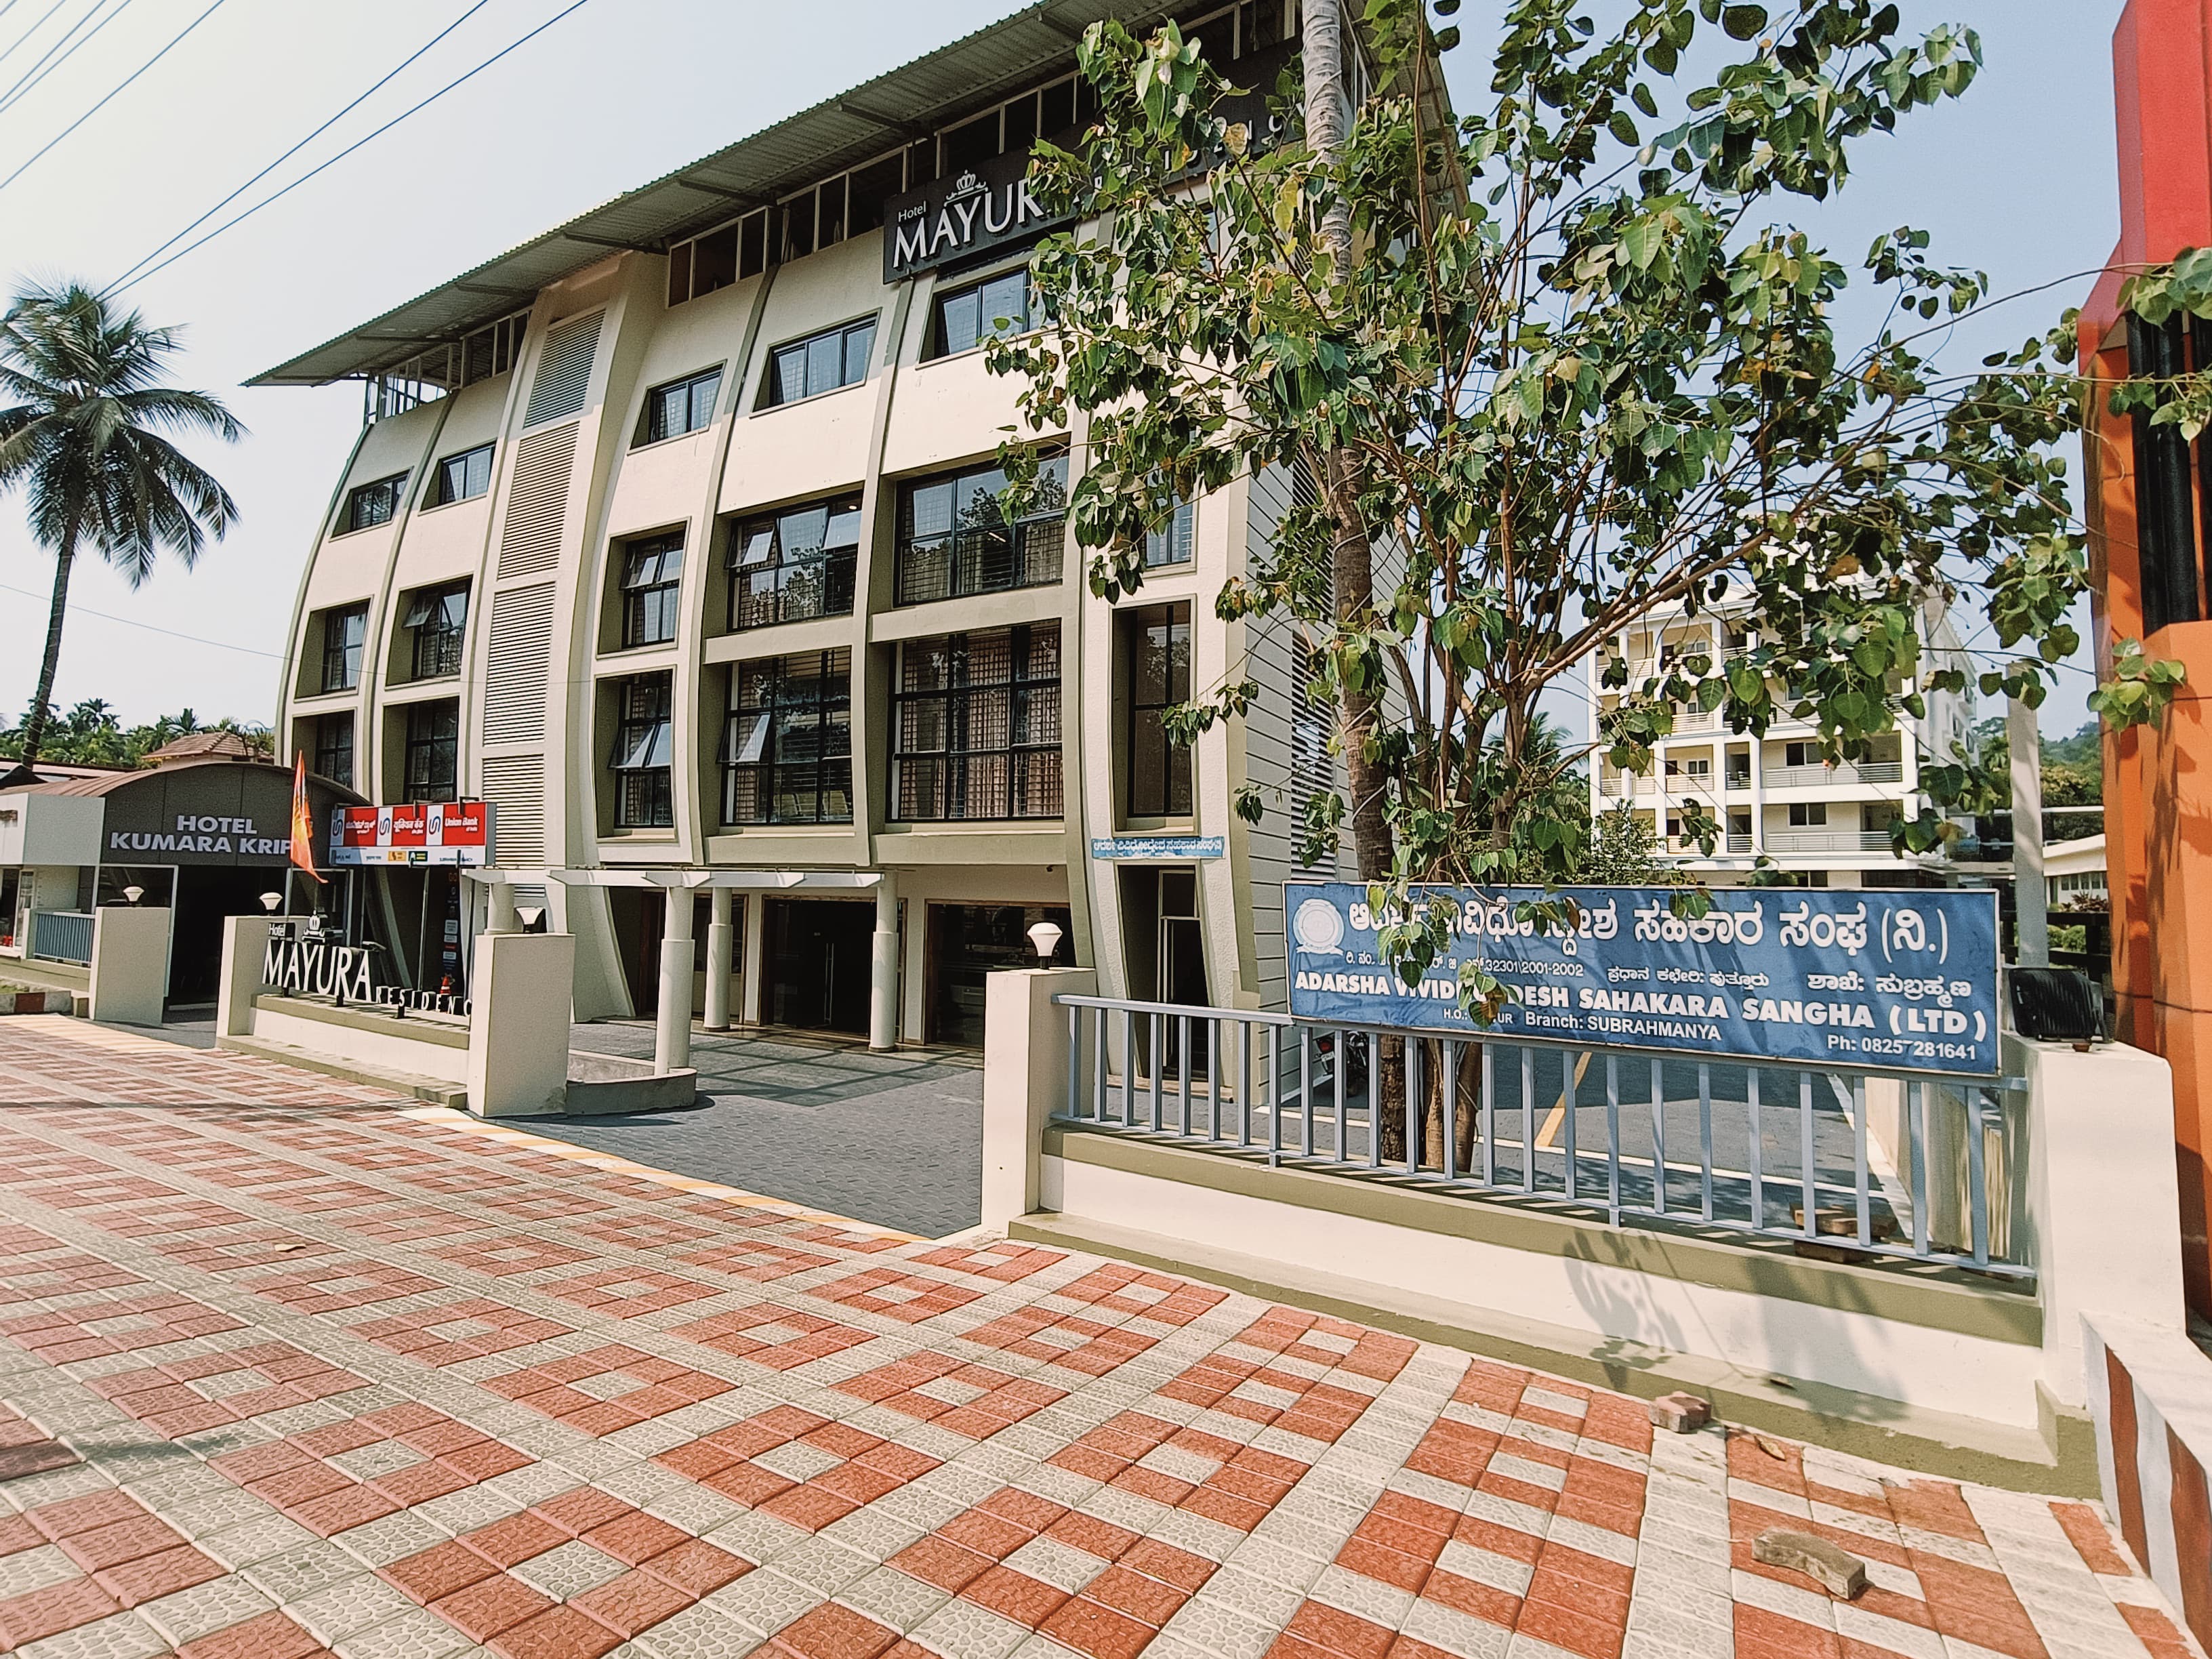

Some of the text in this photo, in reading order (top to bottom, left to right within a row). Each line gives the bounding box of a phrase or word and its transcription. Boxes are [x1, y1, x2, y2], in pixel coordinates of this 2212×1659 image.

[898, 201, 926, 222] Hotel
[893, 178, 1045, 268] MAYUR
[177, 815, 258, 834] HOTEL
[462, 817, 478, 826] Bank
[110, 832, 232, 853] KUMARA
[268, 922, 286, 937] Hotel
[262, 939, 371, 1002] MAYURA
[1294, 972, 1391, 996] ADARSHA
[1578, 988, 1729, 1019] SAHAKARA
[1742, 998, 1876, 1029] SANGHA
[1525, 1010, 1583, 1030] Branch:
[1587, 1016, 1722, 1042] SUBRAHMANYA
[1827, 1034, 1858, 1051] Ph:
